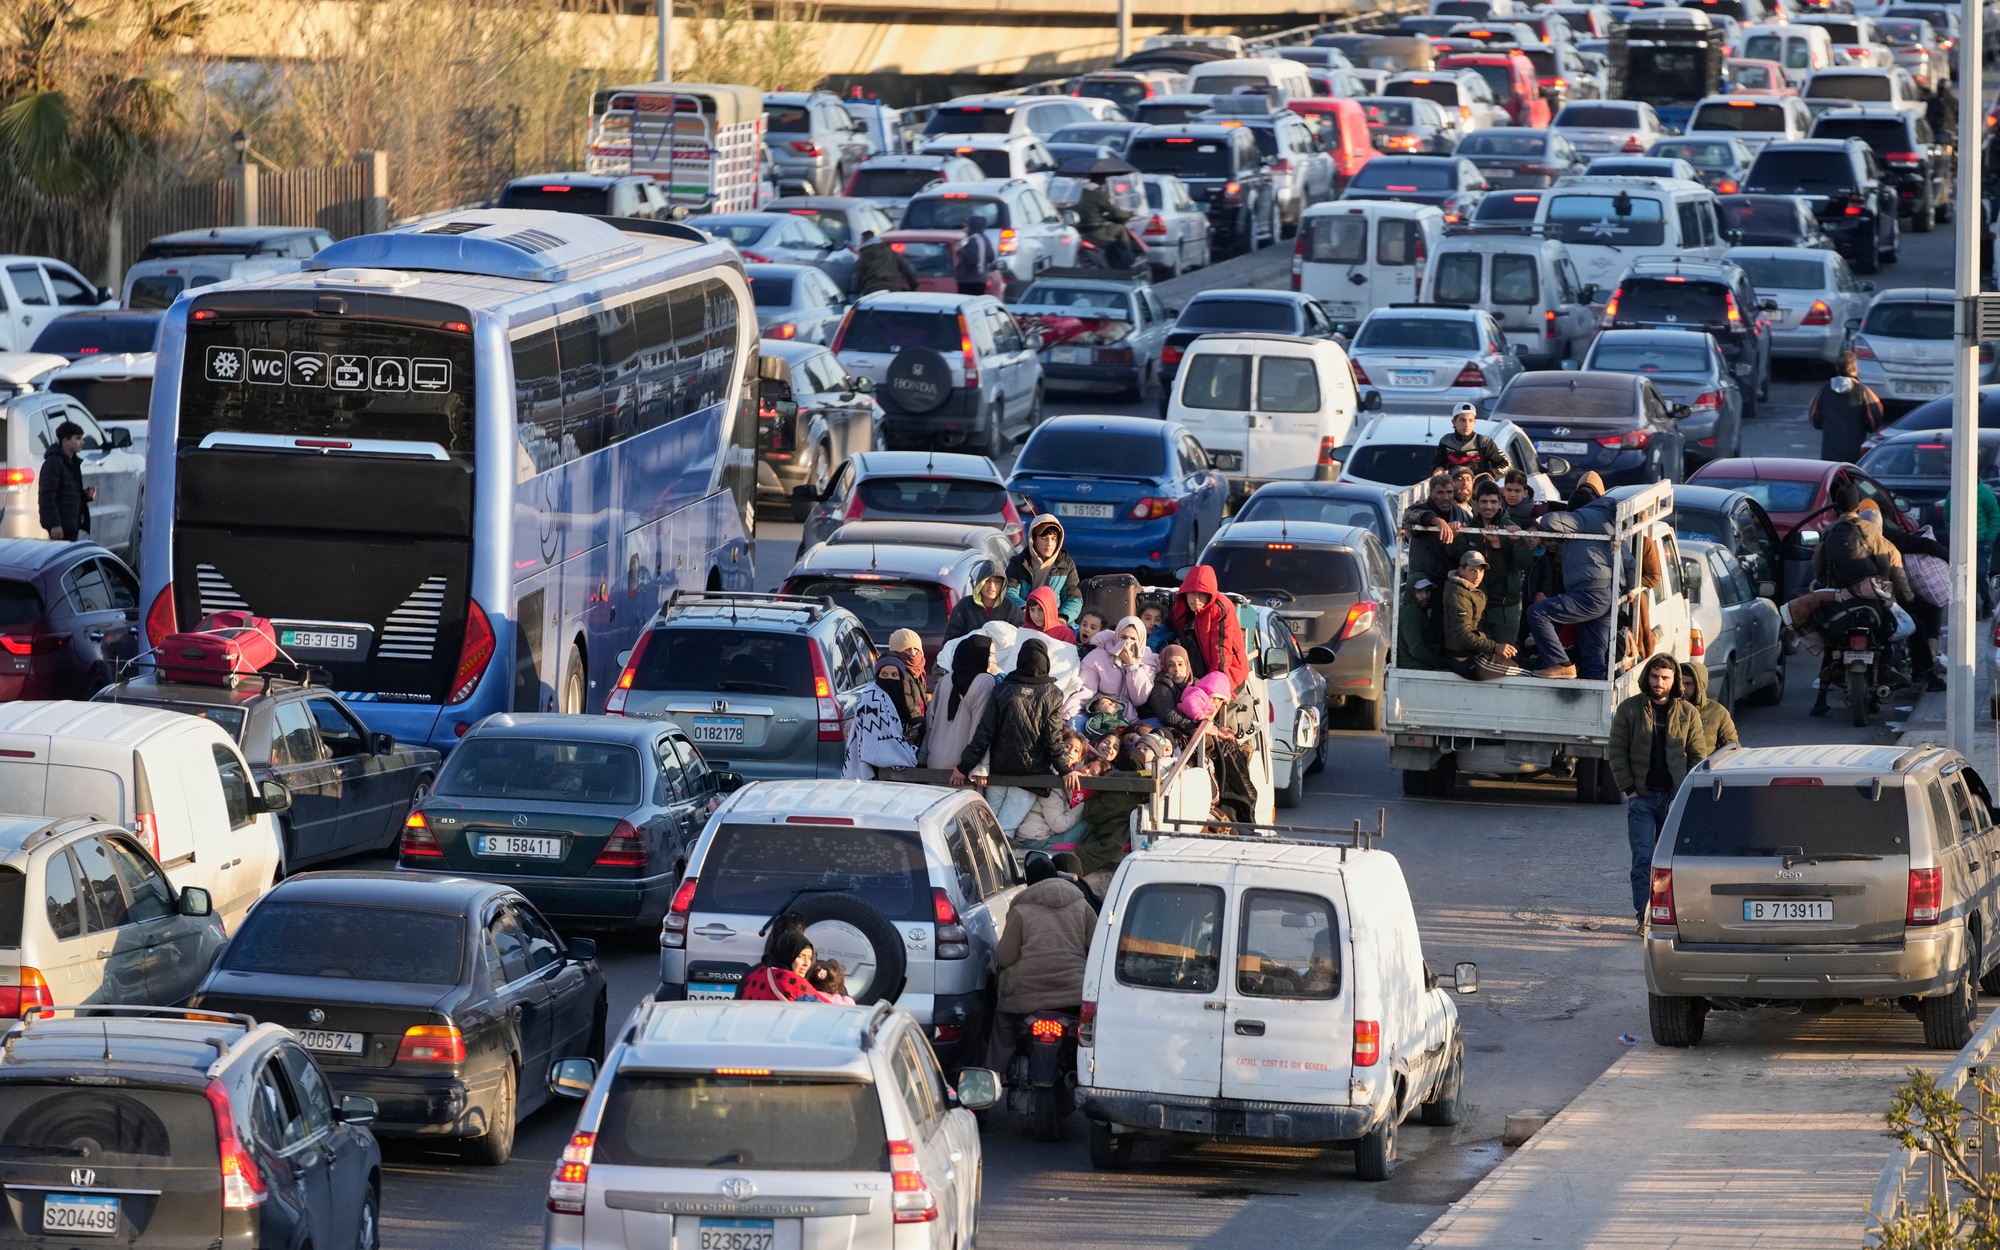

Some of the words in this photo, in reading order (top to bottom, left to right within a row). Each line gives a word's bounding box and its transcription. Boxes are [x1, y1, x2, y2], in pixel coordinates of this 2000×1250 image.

[252, 359, 283, 377] WC
[894, 378, 938, 394] HONDA
[1061, 504, 1068, 514] N
[1074, 505, 1106, 516] 161051
[377, 692, 407, 700] ZHONG
[408, 693, 431, 701] TONG
[694, 726, 743, 741] 0182178
[489, 837, 497, 851] S
[506, 838, 551, 854] 158411
[1775, 870, 1803, 881] Jeep
[1755, 903, 1764, 917] B
[1772, 903, 1823, 918] 713911
[827, 950, 866, 960] CRUISER
[709, 972, 742, 980] PRADO
[298, 1030, 352, 1050] 200574
[1262, 1059, 1277, 1068] COST
[663, 1202, 699, 1211] LAND
[703, 1203, 764, 1212] CRUISER
[767, 1205, 816, 1214] PRADO
[45, 1208, 117, 1230] S204498
[701, 1232, 773, 1250] B236237
